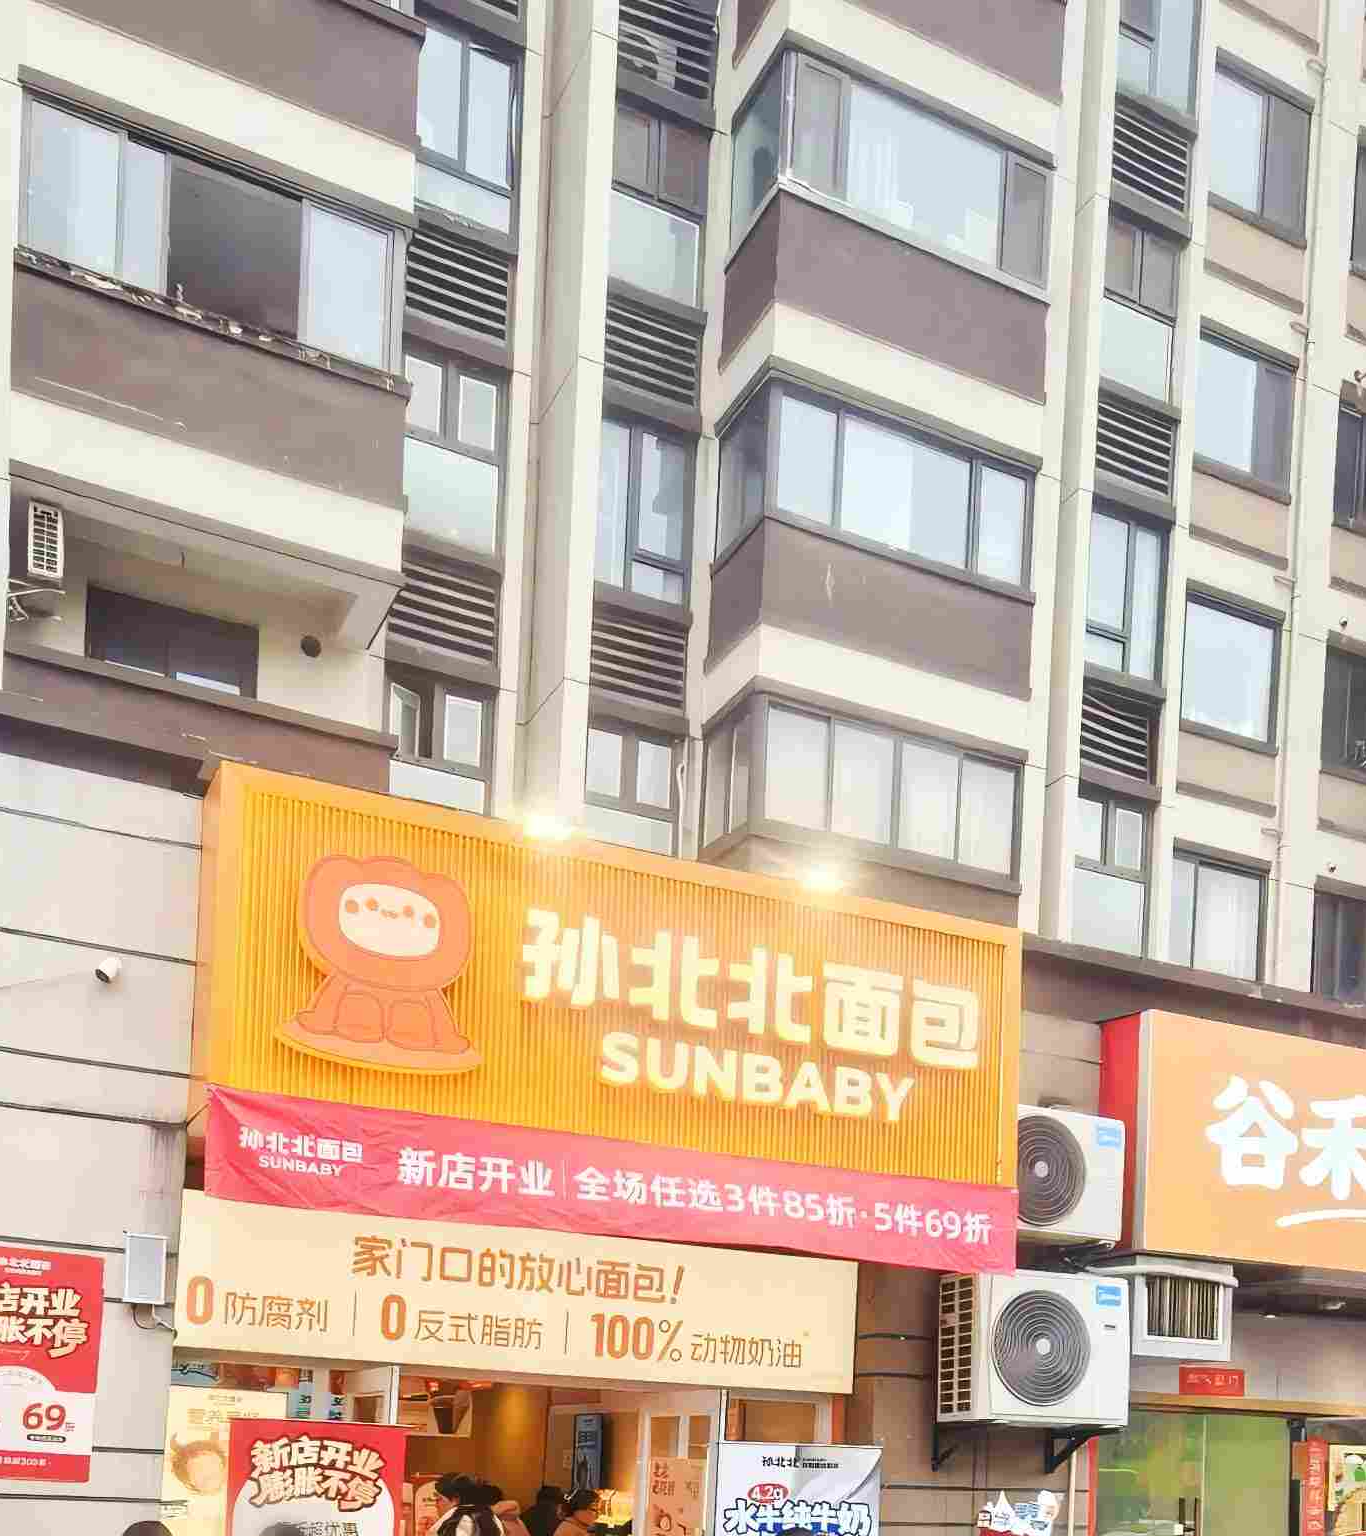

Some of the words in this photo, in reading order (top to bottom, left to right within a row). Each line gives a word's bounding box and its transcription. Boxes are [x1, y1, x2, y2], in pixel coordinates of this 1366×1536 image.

[522, 907, 981, 1071] 孙北北面包
[599, 1031, 916, 1124] SUNBABY
[238, 1125, 364, 1164] 孙北北面包
[258, 1155, 346, 1178] SUNBABY
[397, 1147, 556, 1198] 新店开业
[351, 1234, 684, 1305] 家门口的放心面包!
[186, 1275, 214, 1325] 0
[223, 1291, 329, 1333] 防腐剂
[380, 1294, 408, 1340] 0
[413, 1310, 543, 1351] 反式脂肪
[591, 1313, 684, 1363] 100%
[690, 1330, 803, 1370] 动物奶油
[250, 1434, 385, 1481] 新店开业
